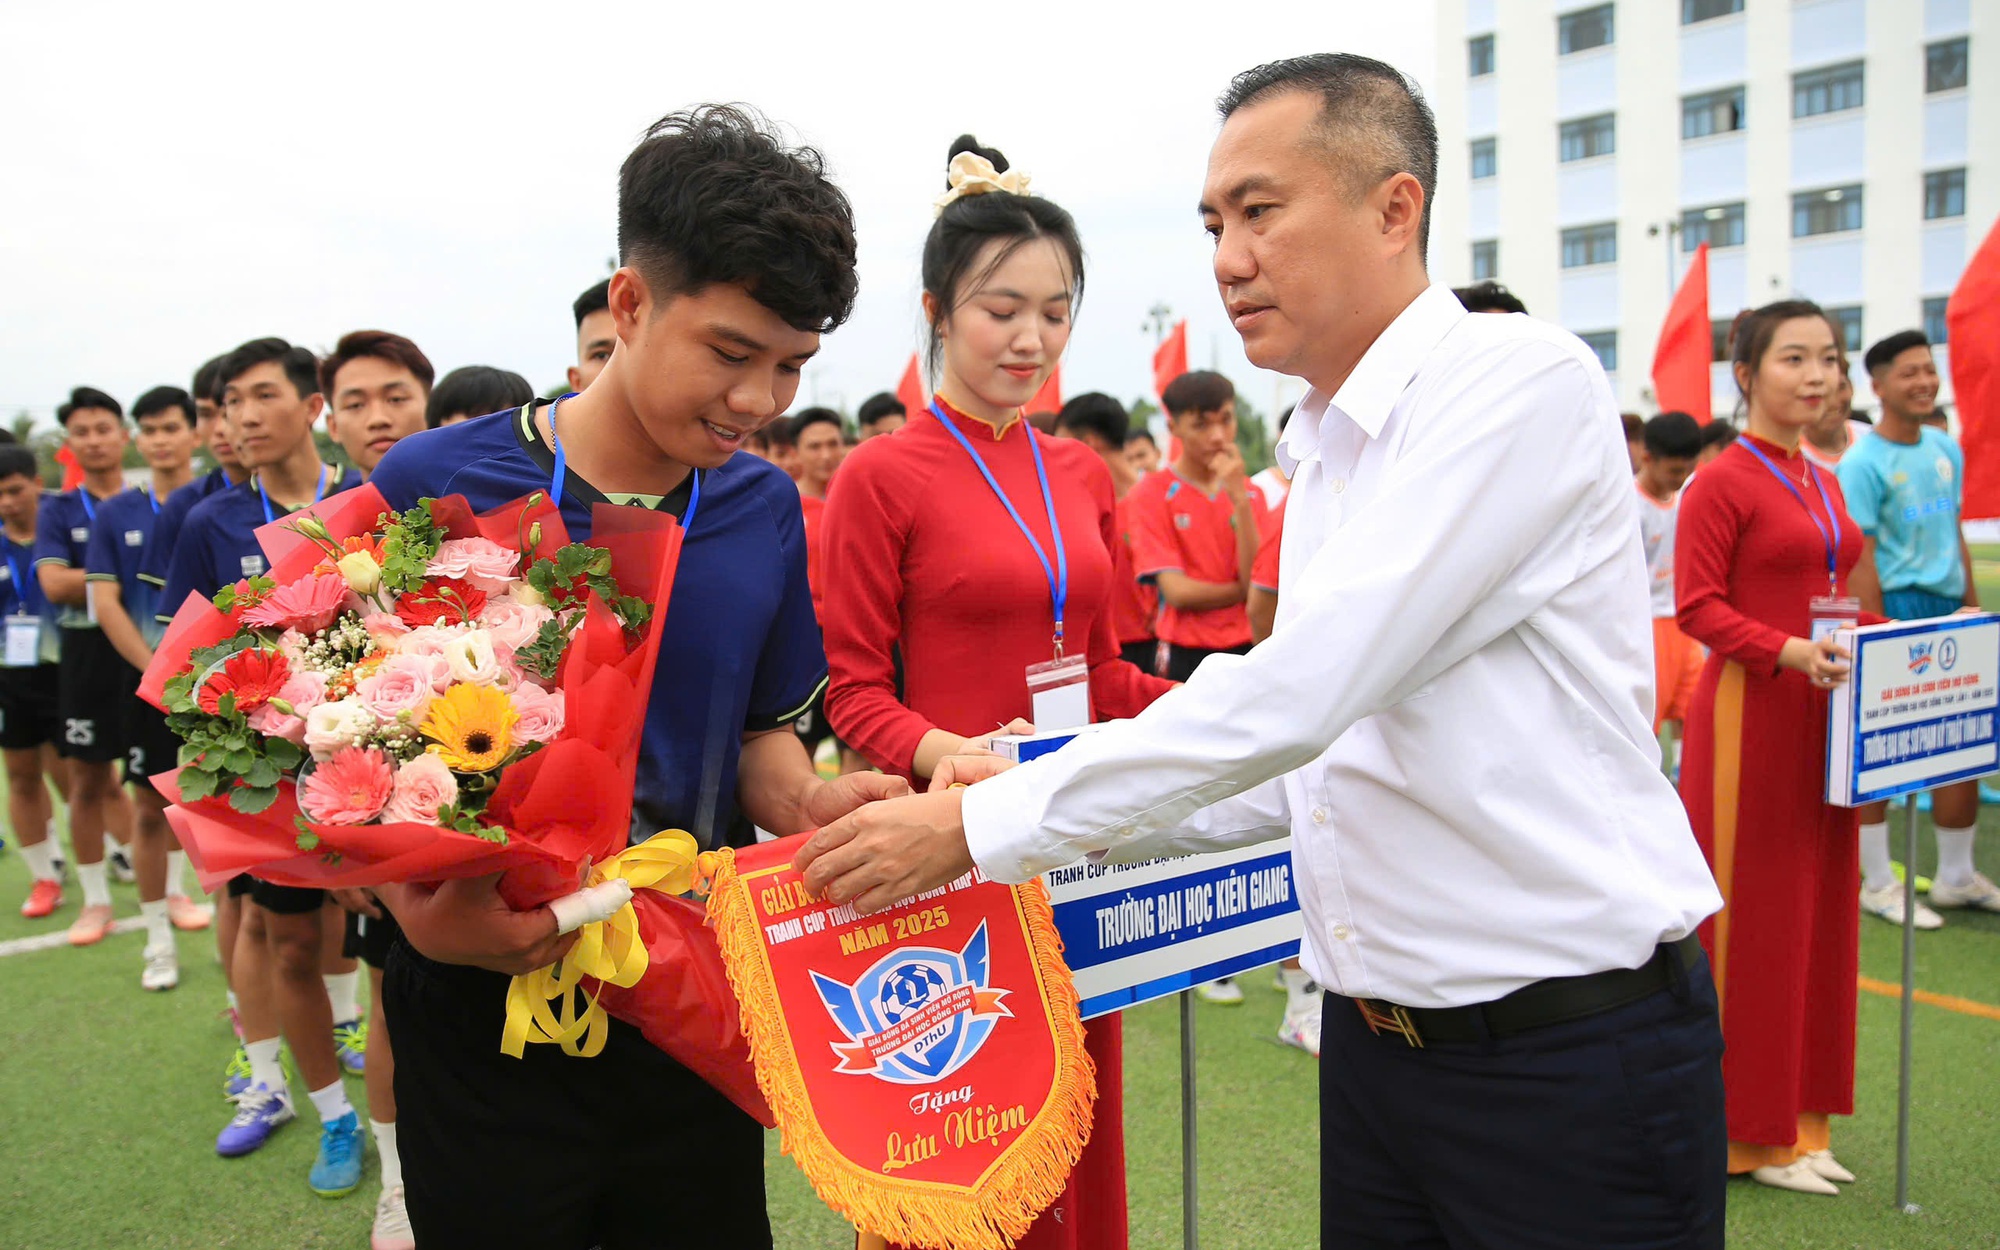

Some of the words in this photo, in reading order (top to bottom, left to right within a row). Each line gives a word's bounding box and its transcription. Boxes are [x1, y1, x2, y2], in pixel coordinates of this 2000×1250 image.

[65, 718, 95, 746] 25
[1049, 864, 1084, 887] TRANH
[761, 875, 796, 916] GIẢI
[1096, 892, 1154, 950] TRƯỜNG
[1158, 891, 1182, 940] ĐẠI
[1185, 884, 1212, 933] HỌC
[1216, 869, 1247, 919] KIÊN
[1250, 864, 1289, 911] GIANG
[765, 917, 804, 945] TRANH
[804, 909, 826, 935] CÚP
[838, 922, 890, 956] NĂM
[892, 905, 950, 940] 2025
[867, 1035, 882, 1047] GIẢI
[910, 1012, 926, 1026] SINH
[914, 1024, 947, 1054] DThU
[915, 1019, 931, 1034] HỌC
[909, 1084, 975, 1115] Tặng
[881, 1131, 941, 1174] Lưu
[944, 1104, 1031, 1148] Niệm
